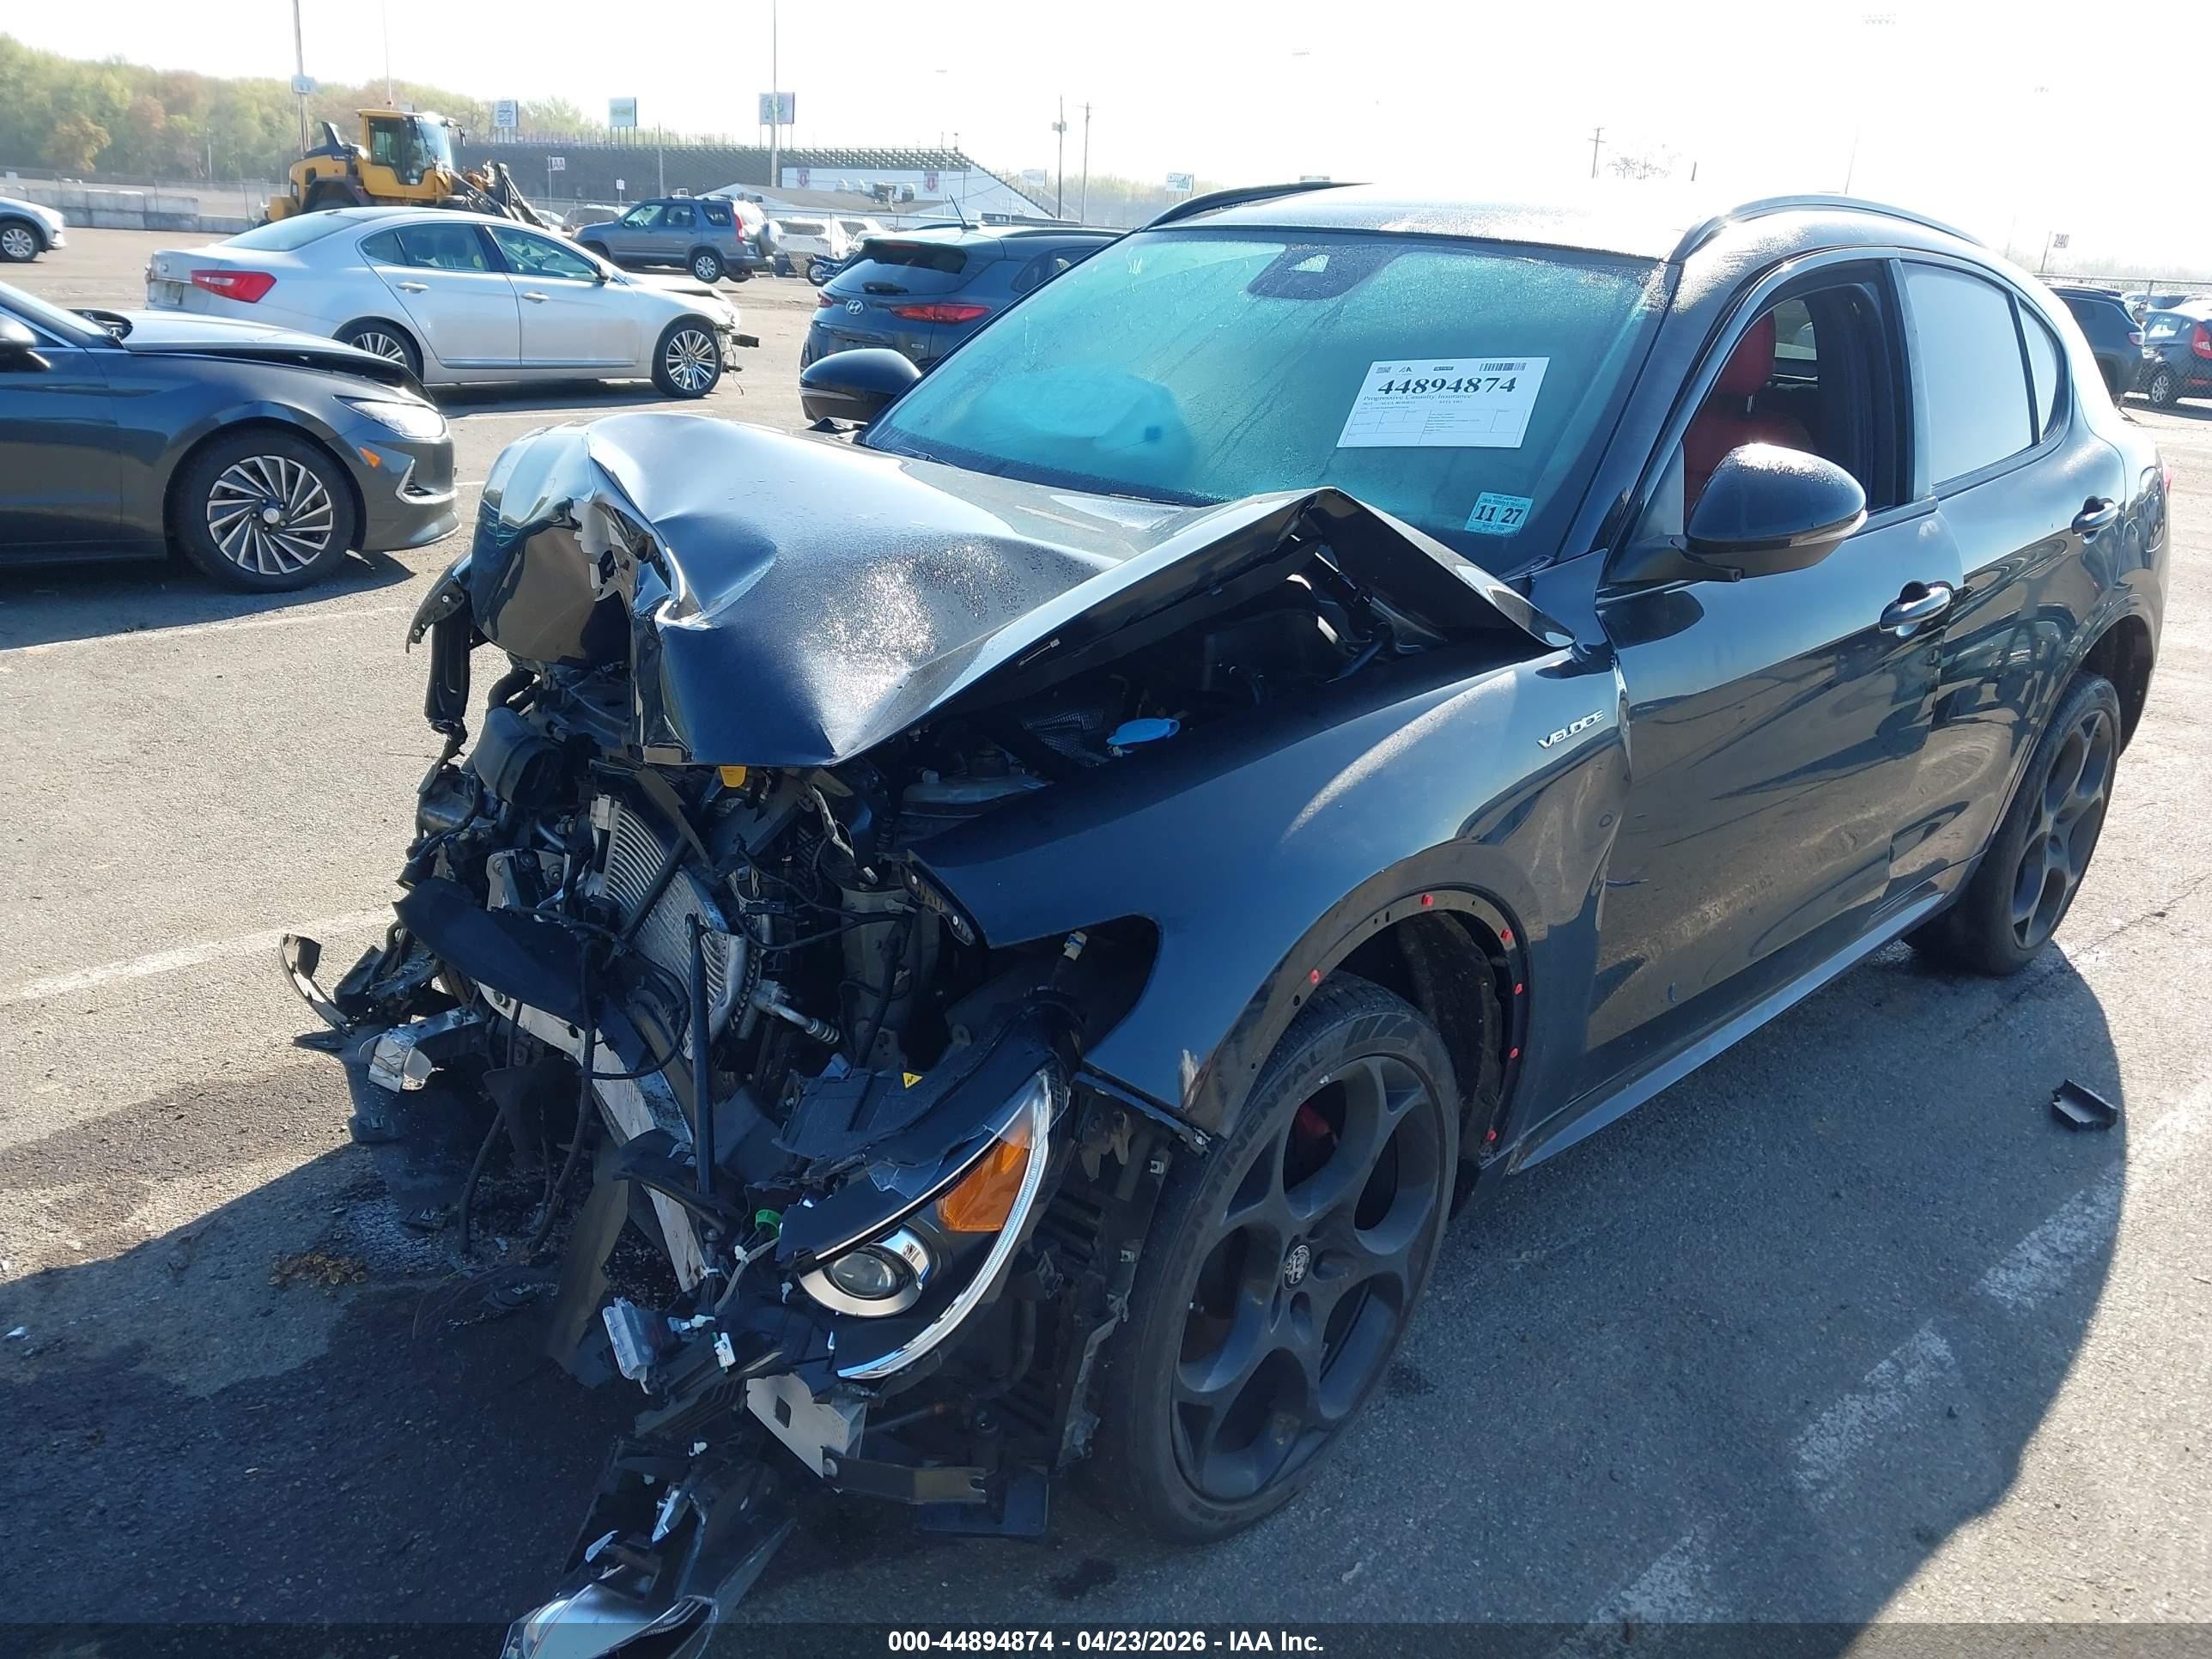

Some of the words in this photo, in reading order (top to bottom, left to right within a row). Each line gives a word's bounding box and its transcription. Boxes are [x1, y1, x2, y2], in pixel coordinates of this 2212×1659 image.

[1377, 377, 1517, 394] 44894874
[1475, 505, 1497, 522] 11
[1501, 507, 1523, 524] 27
[1537, 709, 1606, 749] VELOCE
